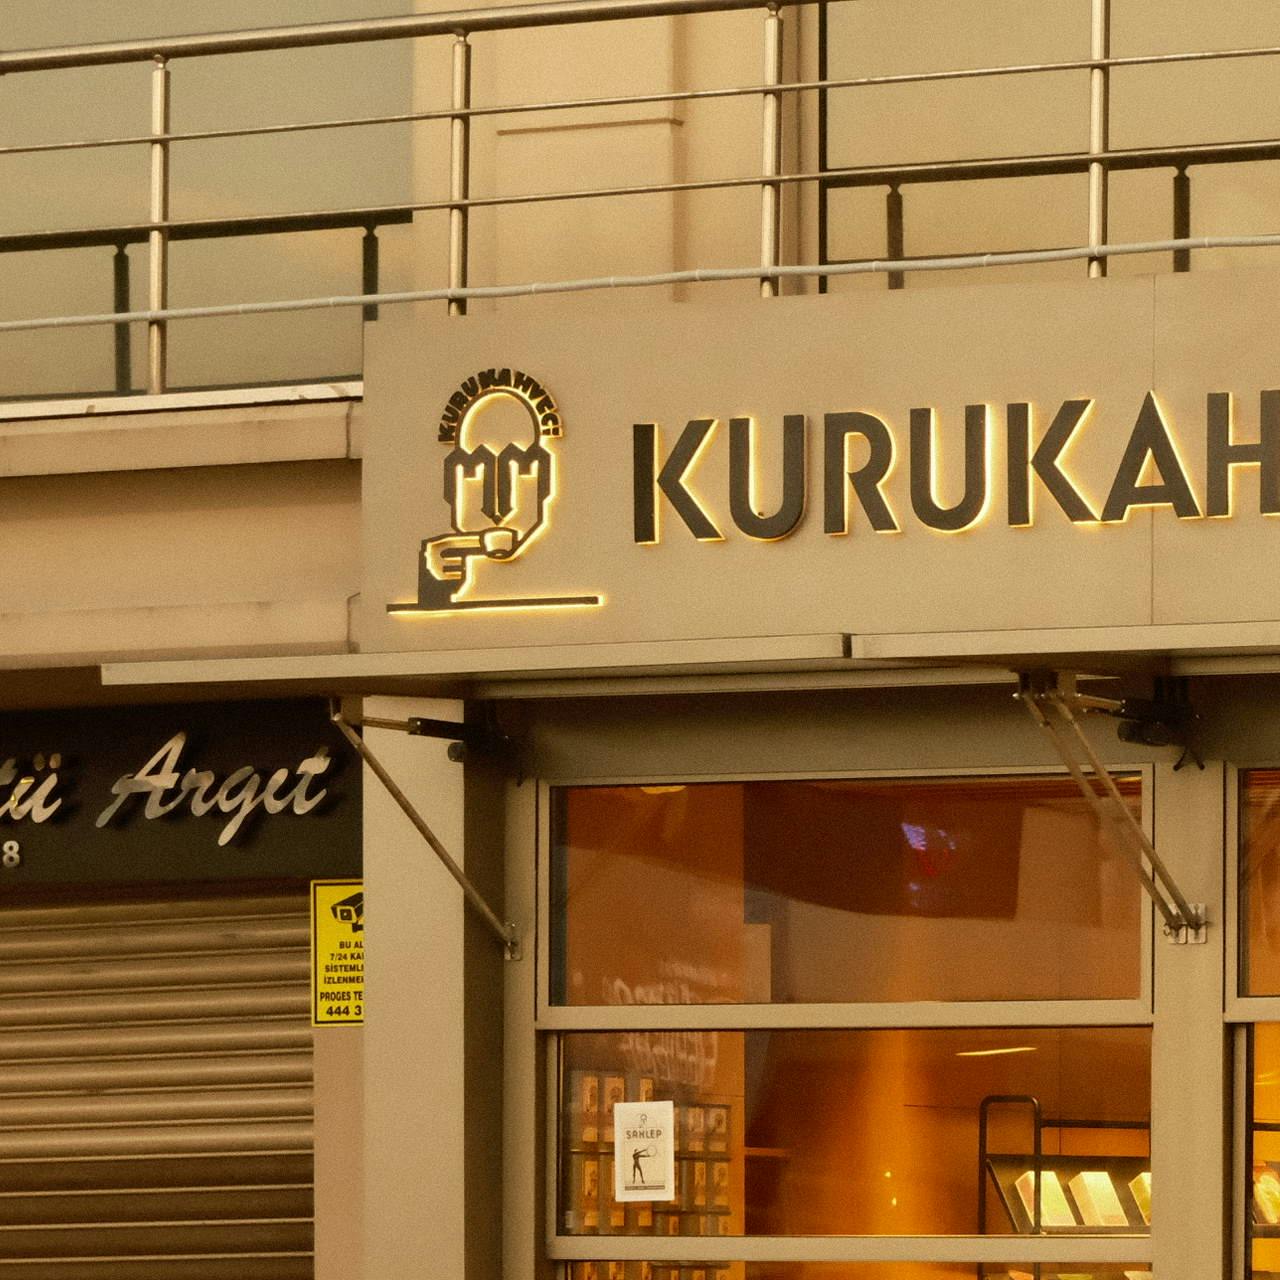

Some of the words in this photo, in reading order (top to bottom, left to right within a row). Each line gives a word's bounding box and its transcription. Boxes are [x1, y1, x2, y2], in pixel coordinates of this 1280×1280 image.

[330, 953, 348, 961] 7/24
[326, 1006, 350, 1016] 444
[625, 1129, 663, 1139] SAHLEP
